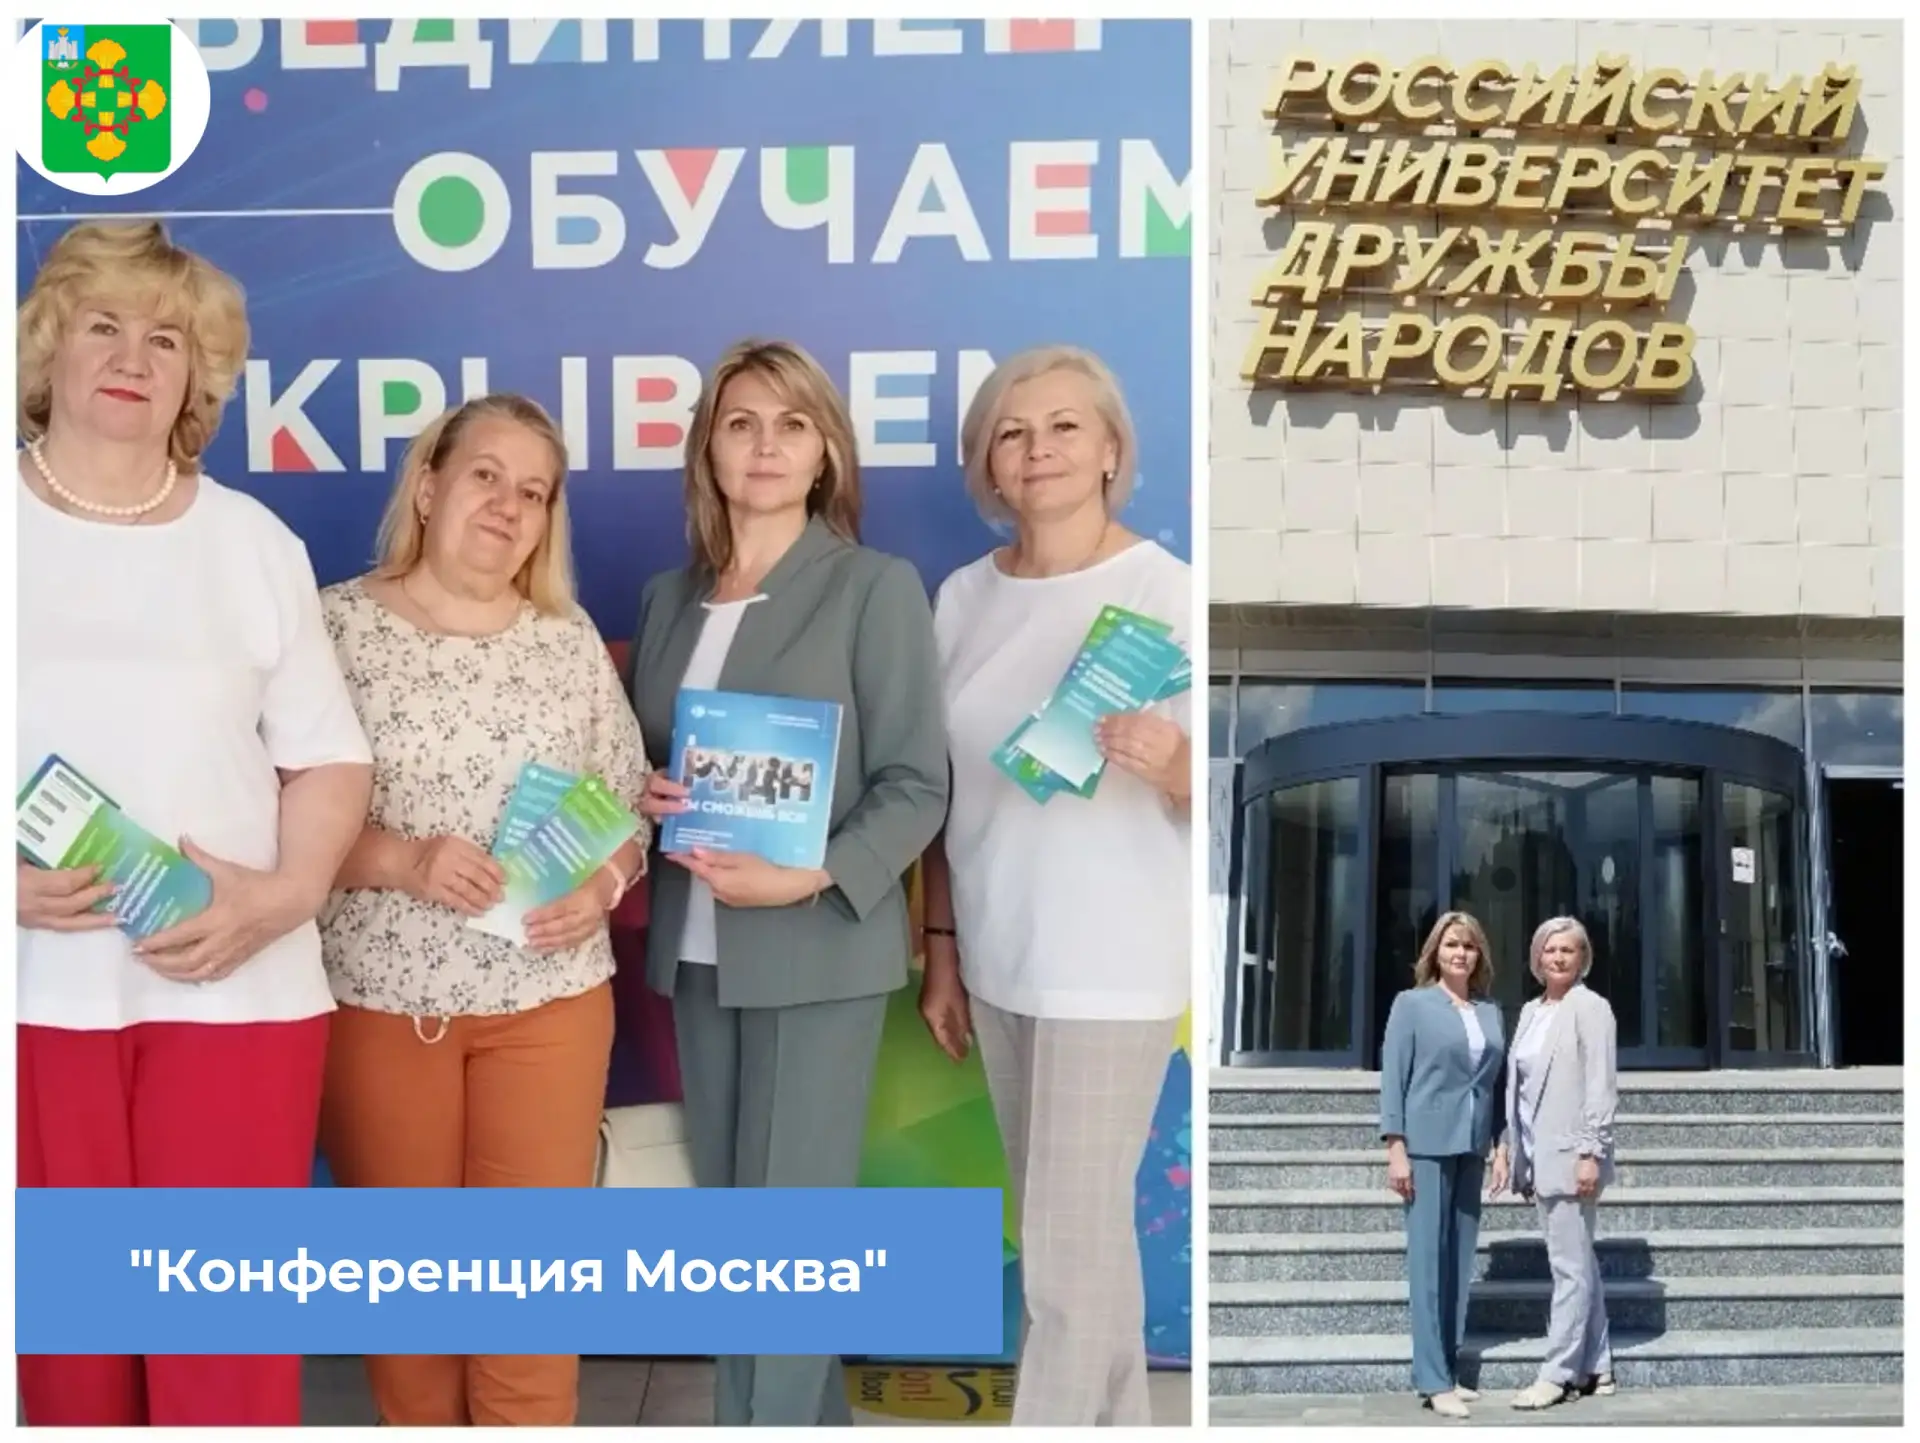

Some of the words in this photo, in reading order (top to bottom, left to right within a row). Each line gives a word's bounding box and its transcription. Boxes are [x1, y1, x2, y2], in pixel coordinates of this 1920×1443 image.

[1262, 51, 1863, 141] РОССИЙСКИЙ
[393, 138, 1192, 272] ОБУЧАЕМ
[1255, 135, 1887, 224] УНИВЕРСИТЕТ
[1251, 220, 1690, 306] ДРУЖБЫ
[1240, 307, 1697, 402] НАРОДОВ
[245, 349, 1000, 472] КРВЕ
